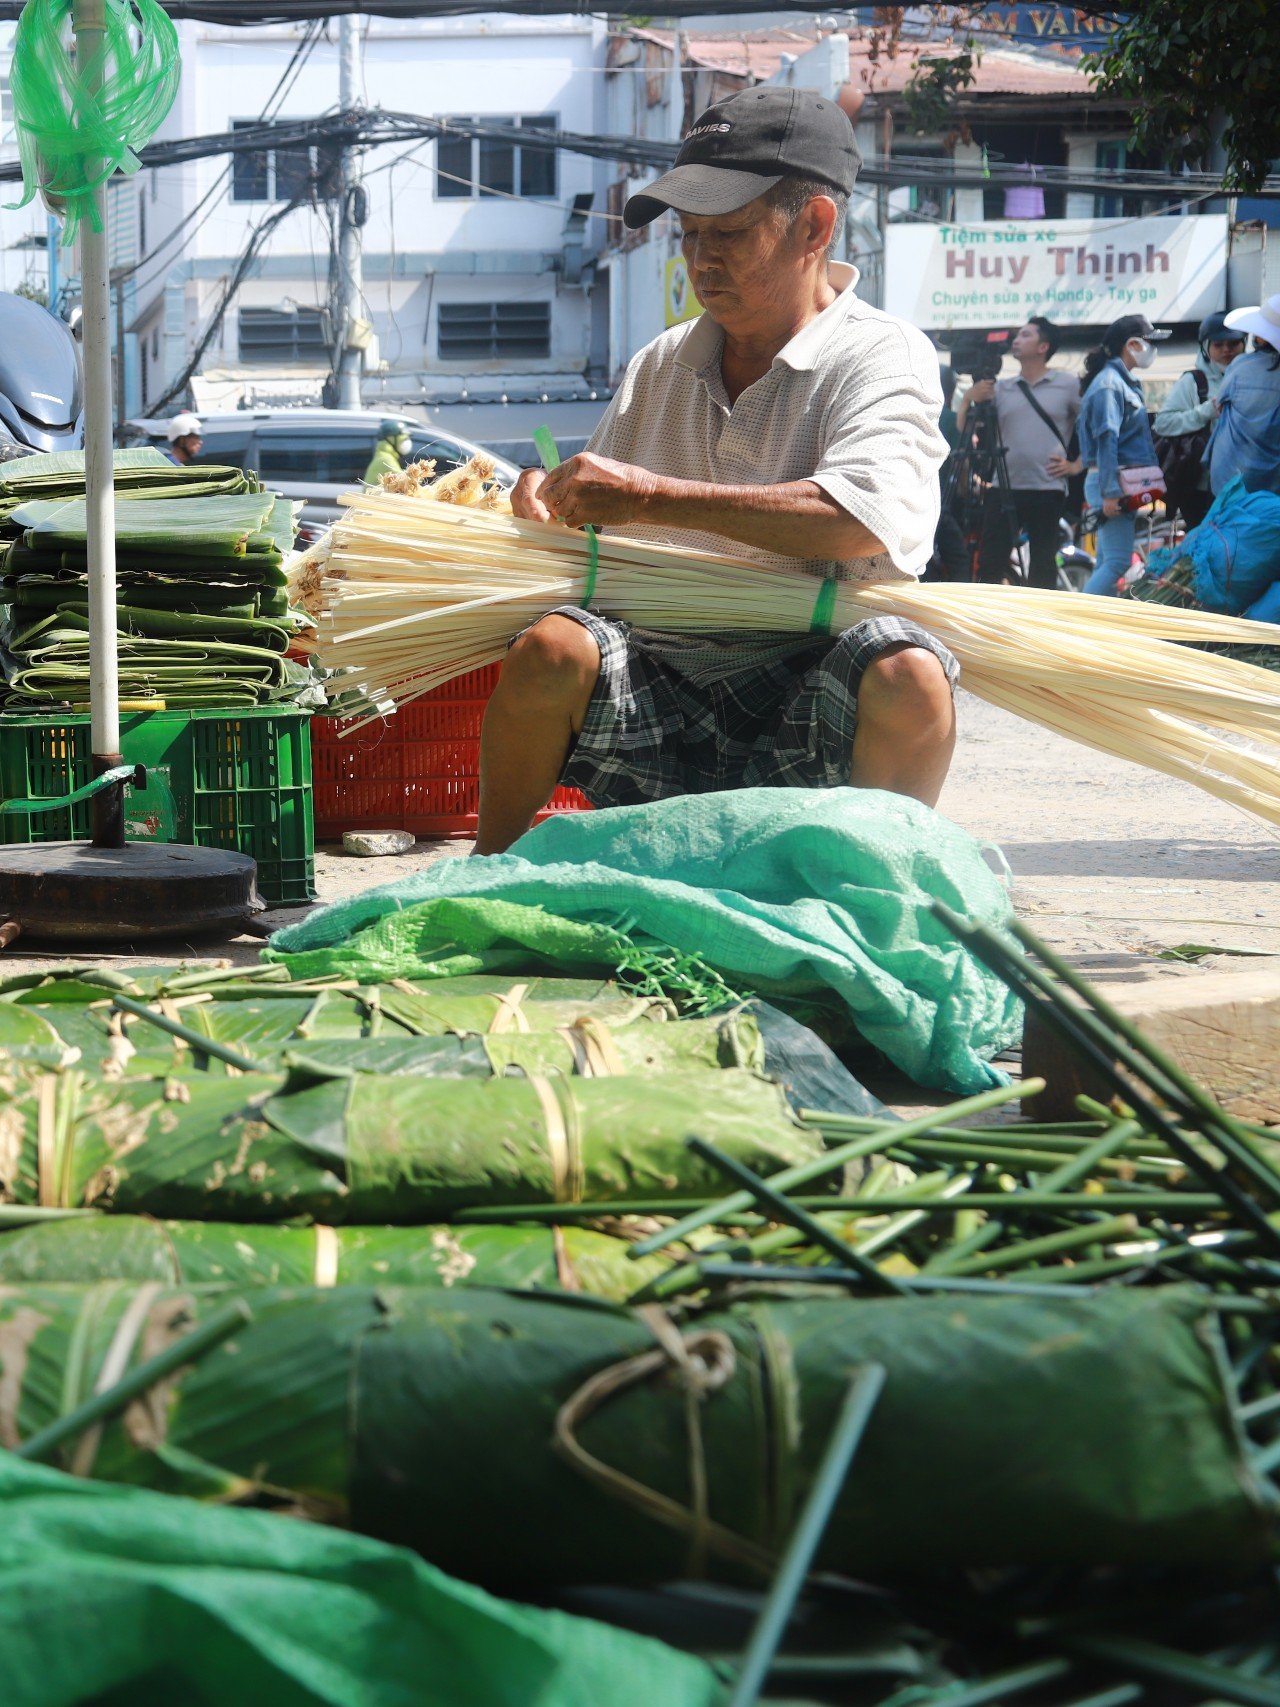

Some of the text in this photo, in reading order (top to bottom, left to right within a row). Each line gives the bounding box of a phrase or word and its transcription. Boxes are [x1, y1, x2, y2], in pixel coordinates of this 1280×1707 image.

[939, 227, 987, 247] Tiệm
[946, 244, 1169, 284] Huy Thịnh
[932, 290, 988, 307] Chuyên
[1025, 292, 1043, 303] xe
[1046, 288, 1093, 301] Honda
[1108, 286, 1134, 303] Tay
[1139, 288, 1157, 303] ga
